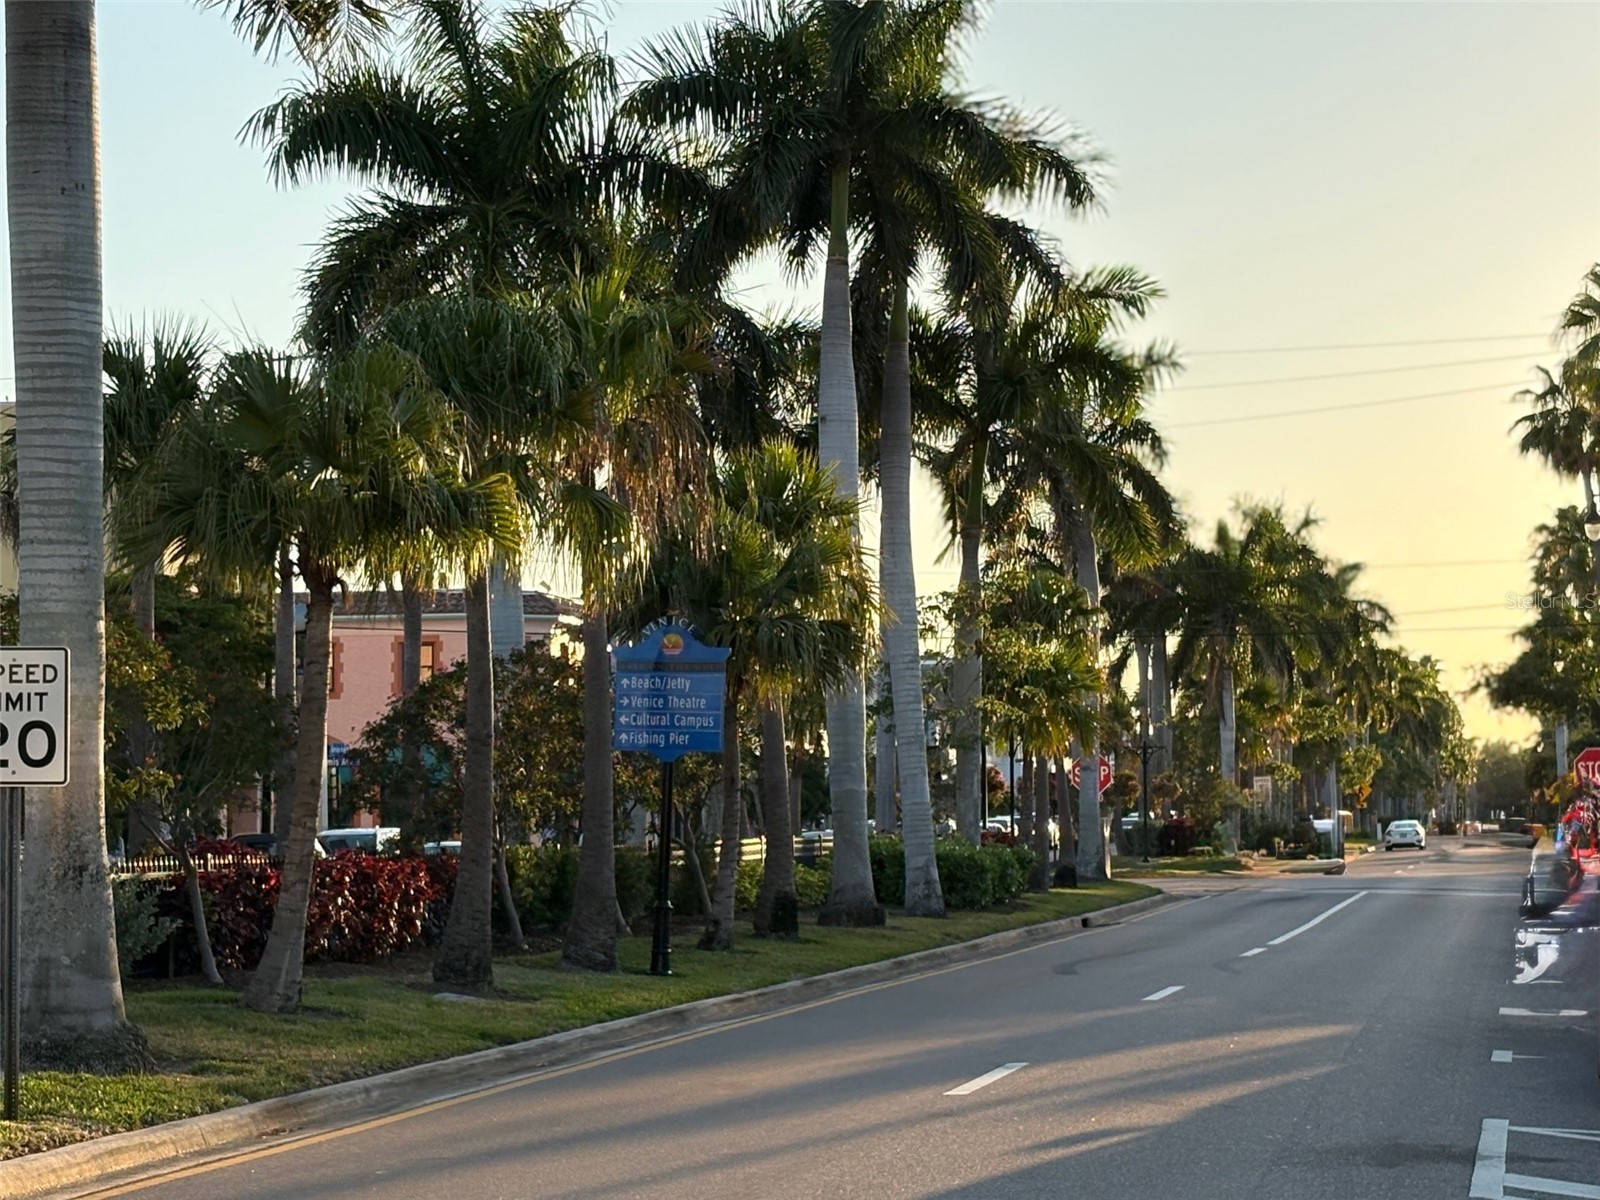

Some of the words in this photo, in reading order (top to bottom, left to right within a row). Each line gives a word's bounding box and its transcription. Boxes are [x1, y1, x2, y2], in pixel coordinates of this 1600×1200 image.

[642, 616, 695, 635] VENICE
[630, 676, 691, 692] Beach/Jetty
[631, 696, 664, 708] Venice
[667, 695, 706, 709] Theatre
[630, 713, 670, 726] Cultural
[674, 714, 714, 729] Campus
[0, 720, 57, 768] 0
[629, 730, 665, 747] Fishing
[669, 732, 690, 745] Pier
[1074, 766, 1109, 782] SP
